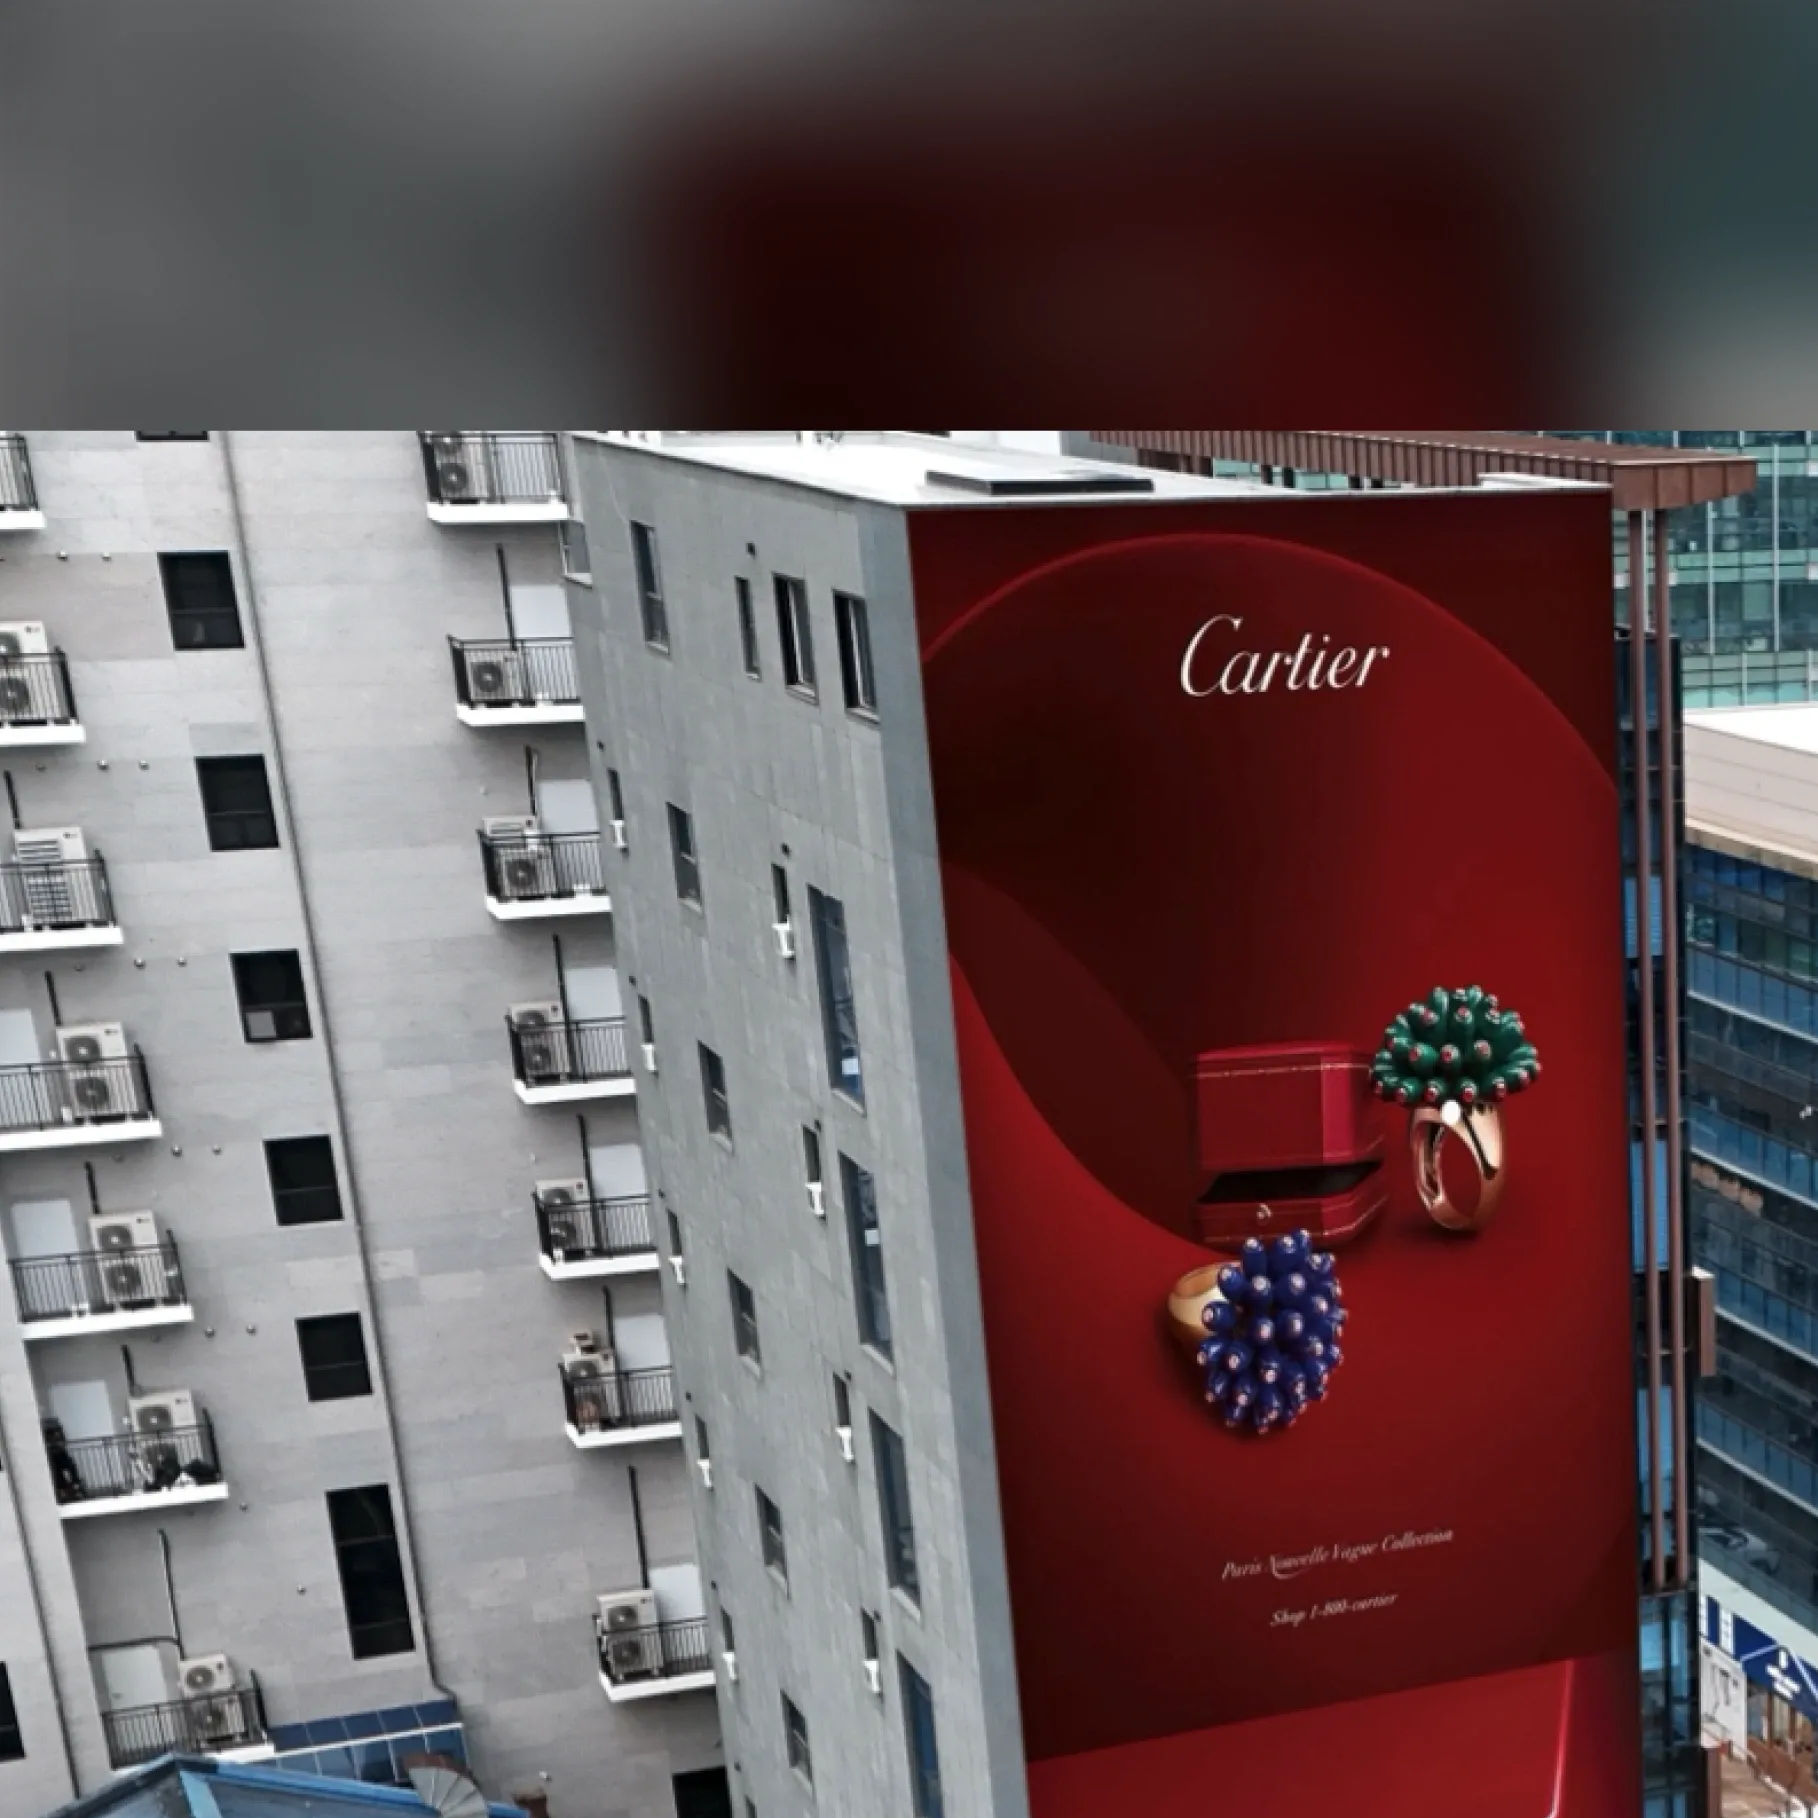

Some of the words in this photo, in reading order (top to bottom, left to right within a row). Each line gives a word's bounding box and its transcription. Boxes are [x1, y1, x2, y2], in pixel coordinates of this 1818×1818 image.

[1180, 613, 1390, 698] Cartier
[1221, 1558, 1263, 1581] Paris
[1381, 1528, 1454, 1553] Collection
[1269, 1607, 1306, 1628] Shop
